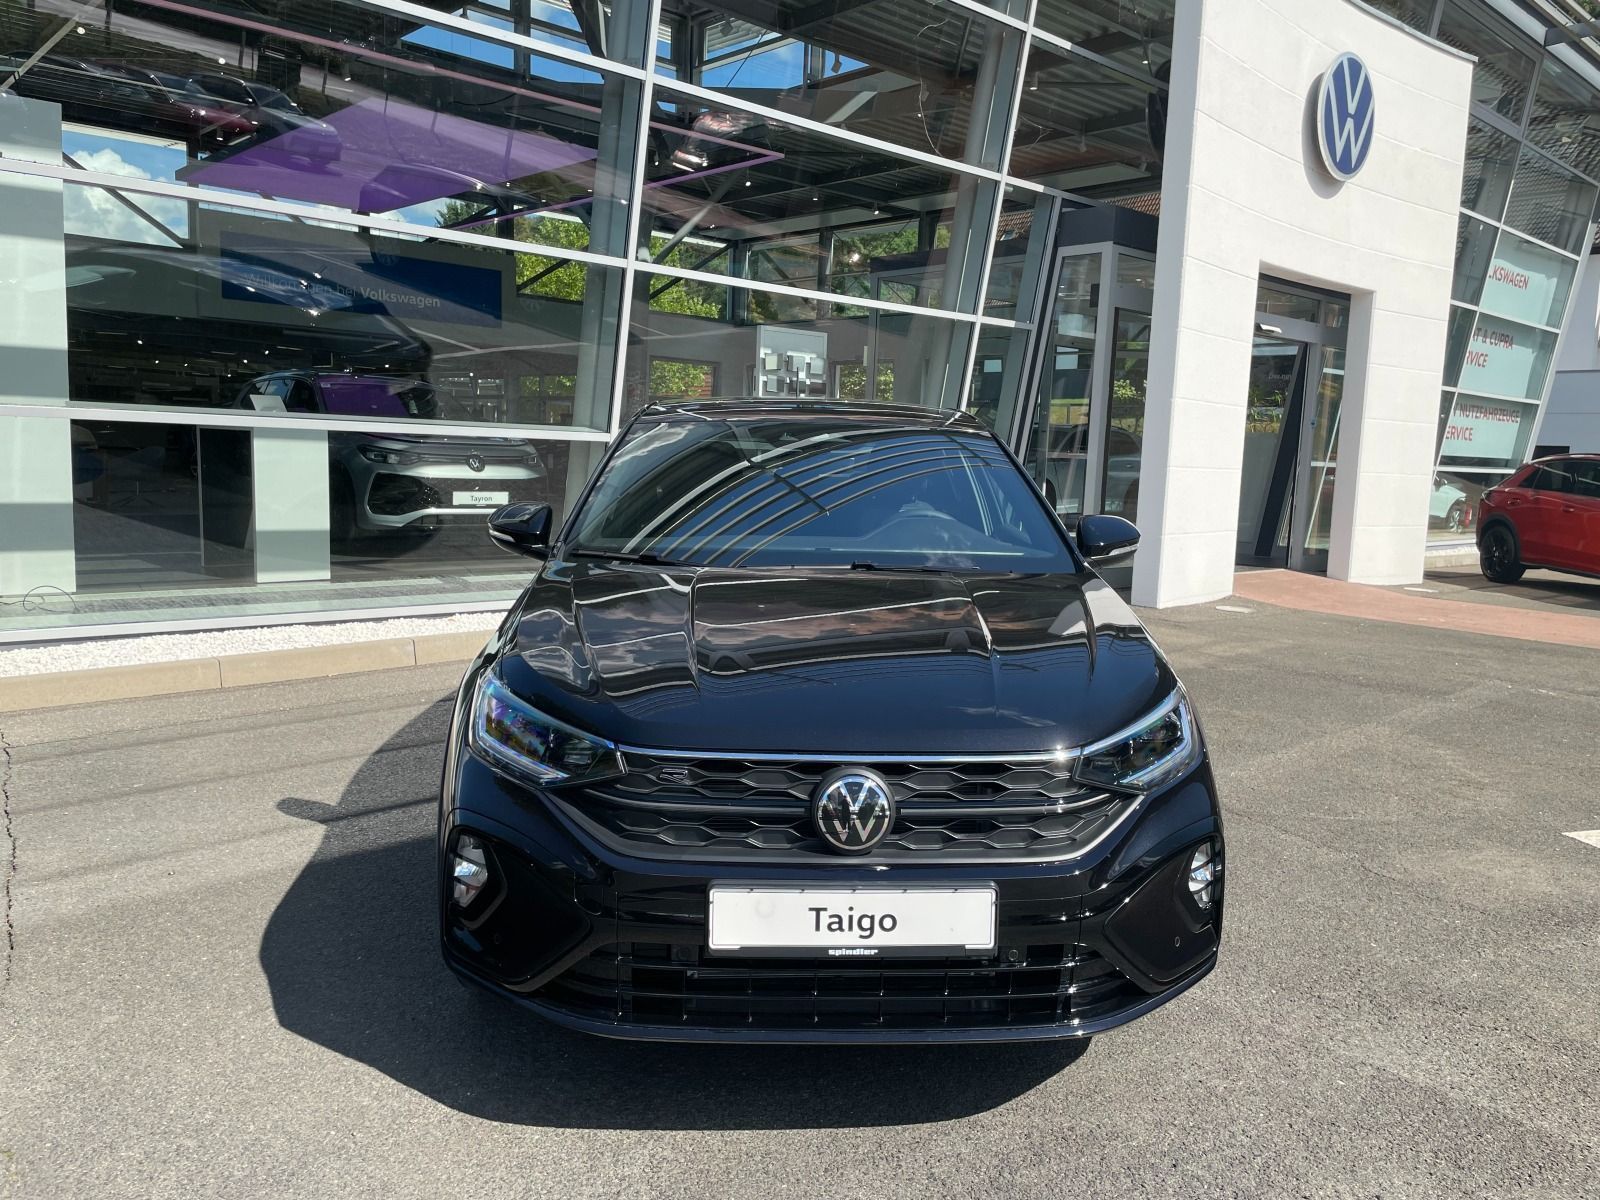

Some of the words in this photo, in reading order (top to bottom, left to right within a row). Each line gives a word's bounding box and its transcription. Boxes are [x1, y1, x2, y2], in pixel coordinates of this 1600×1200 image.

[1488, 264, 1530, 290] KSWAGEN
[361, 287, 440, 308] Volkswagen
[1490, 331, 1514, 350] CUPRA
[1460, 403, 1520, 423] NUTZFAHRZEUGE
[817, 773, 891, 848] VW
[808, 906, 898, 939] Taigo
